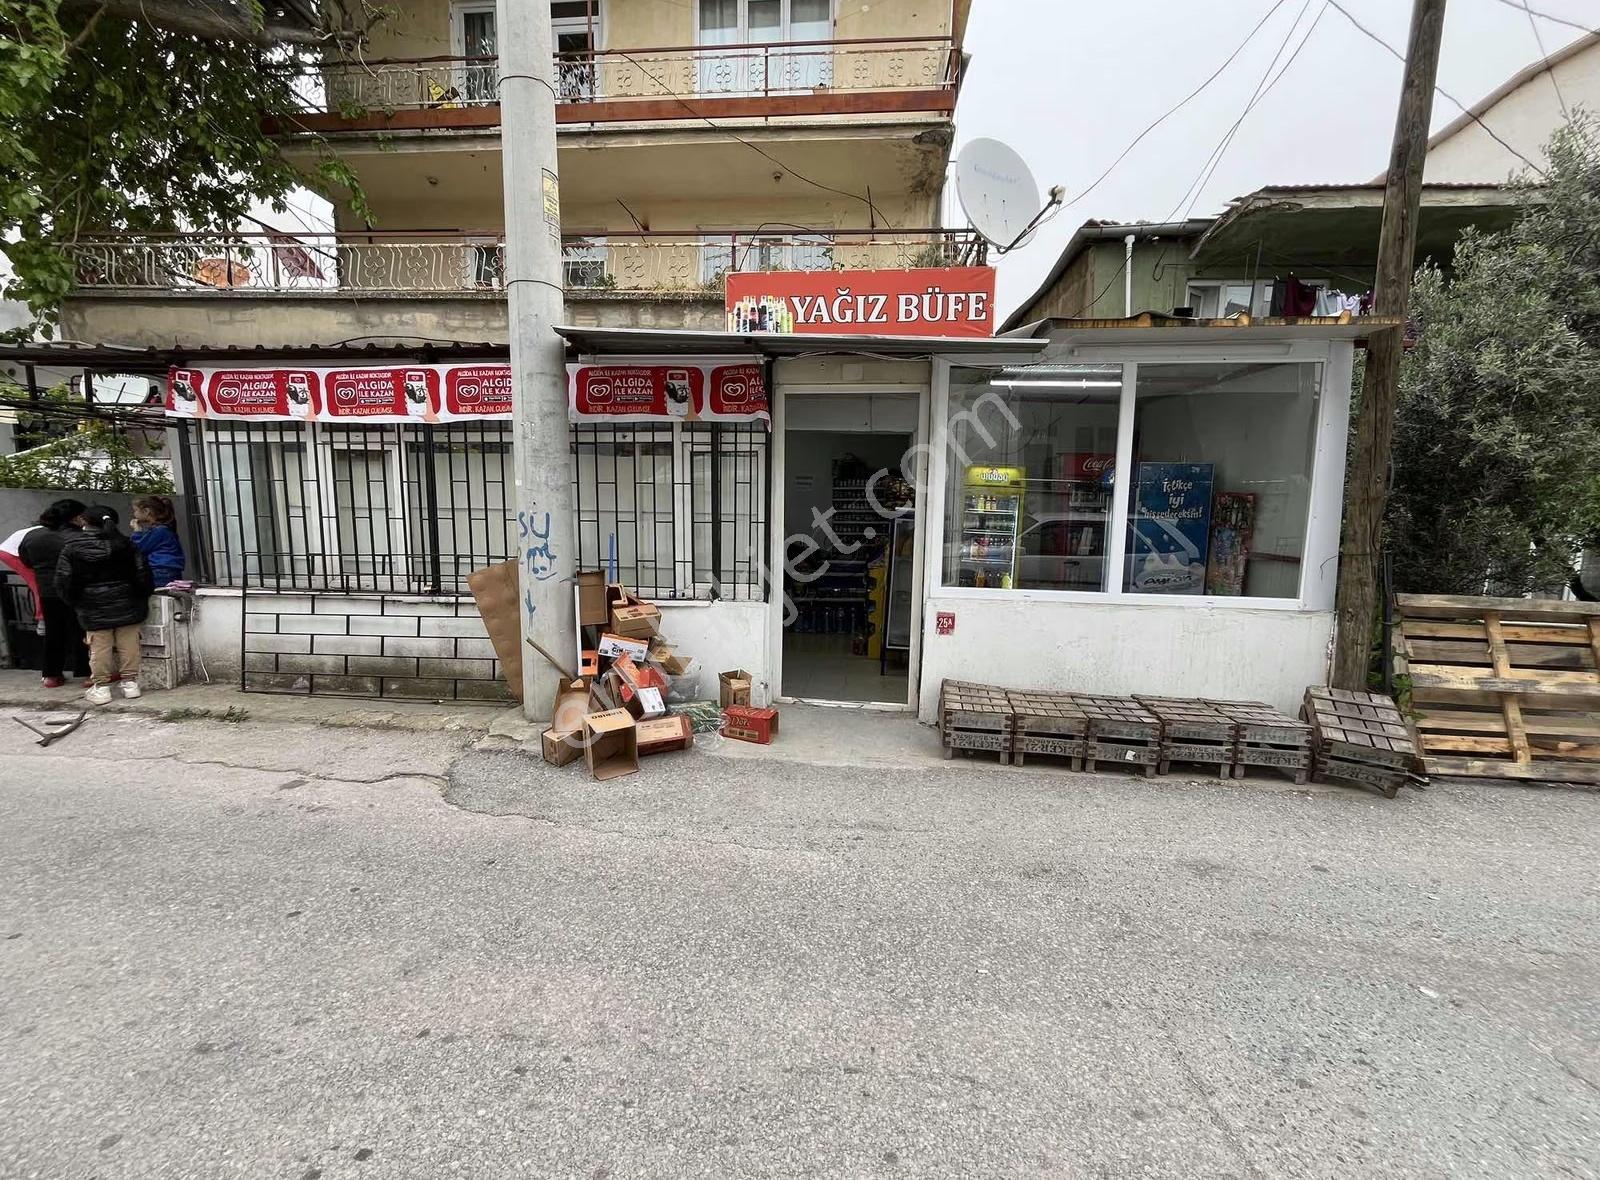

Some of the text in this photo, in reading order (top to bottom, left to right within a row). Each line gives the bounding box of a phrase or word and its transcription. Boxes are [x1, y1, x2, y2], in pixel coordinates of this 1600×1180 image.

[789, 287, 987, 323] YAĞIZ BÜFE
[627, 387, 653, 395] KAZAN
